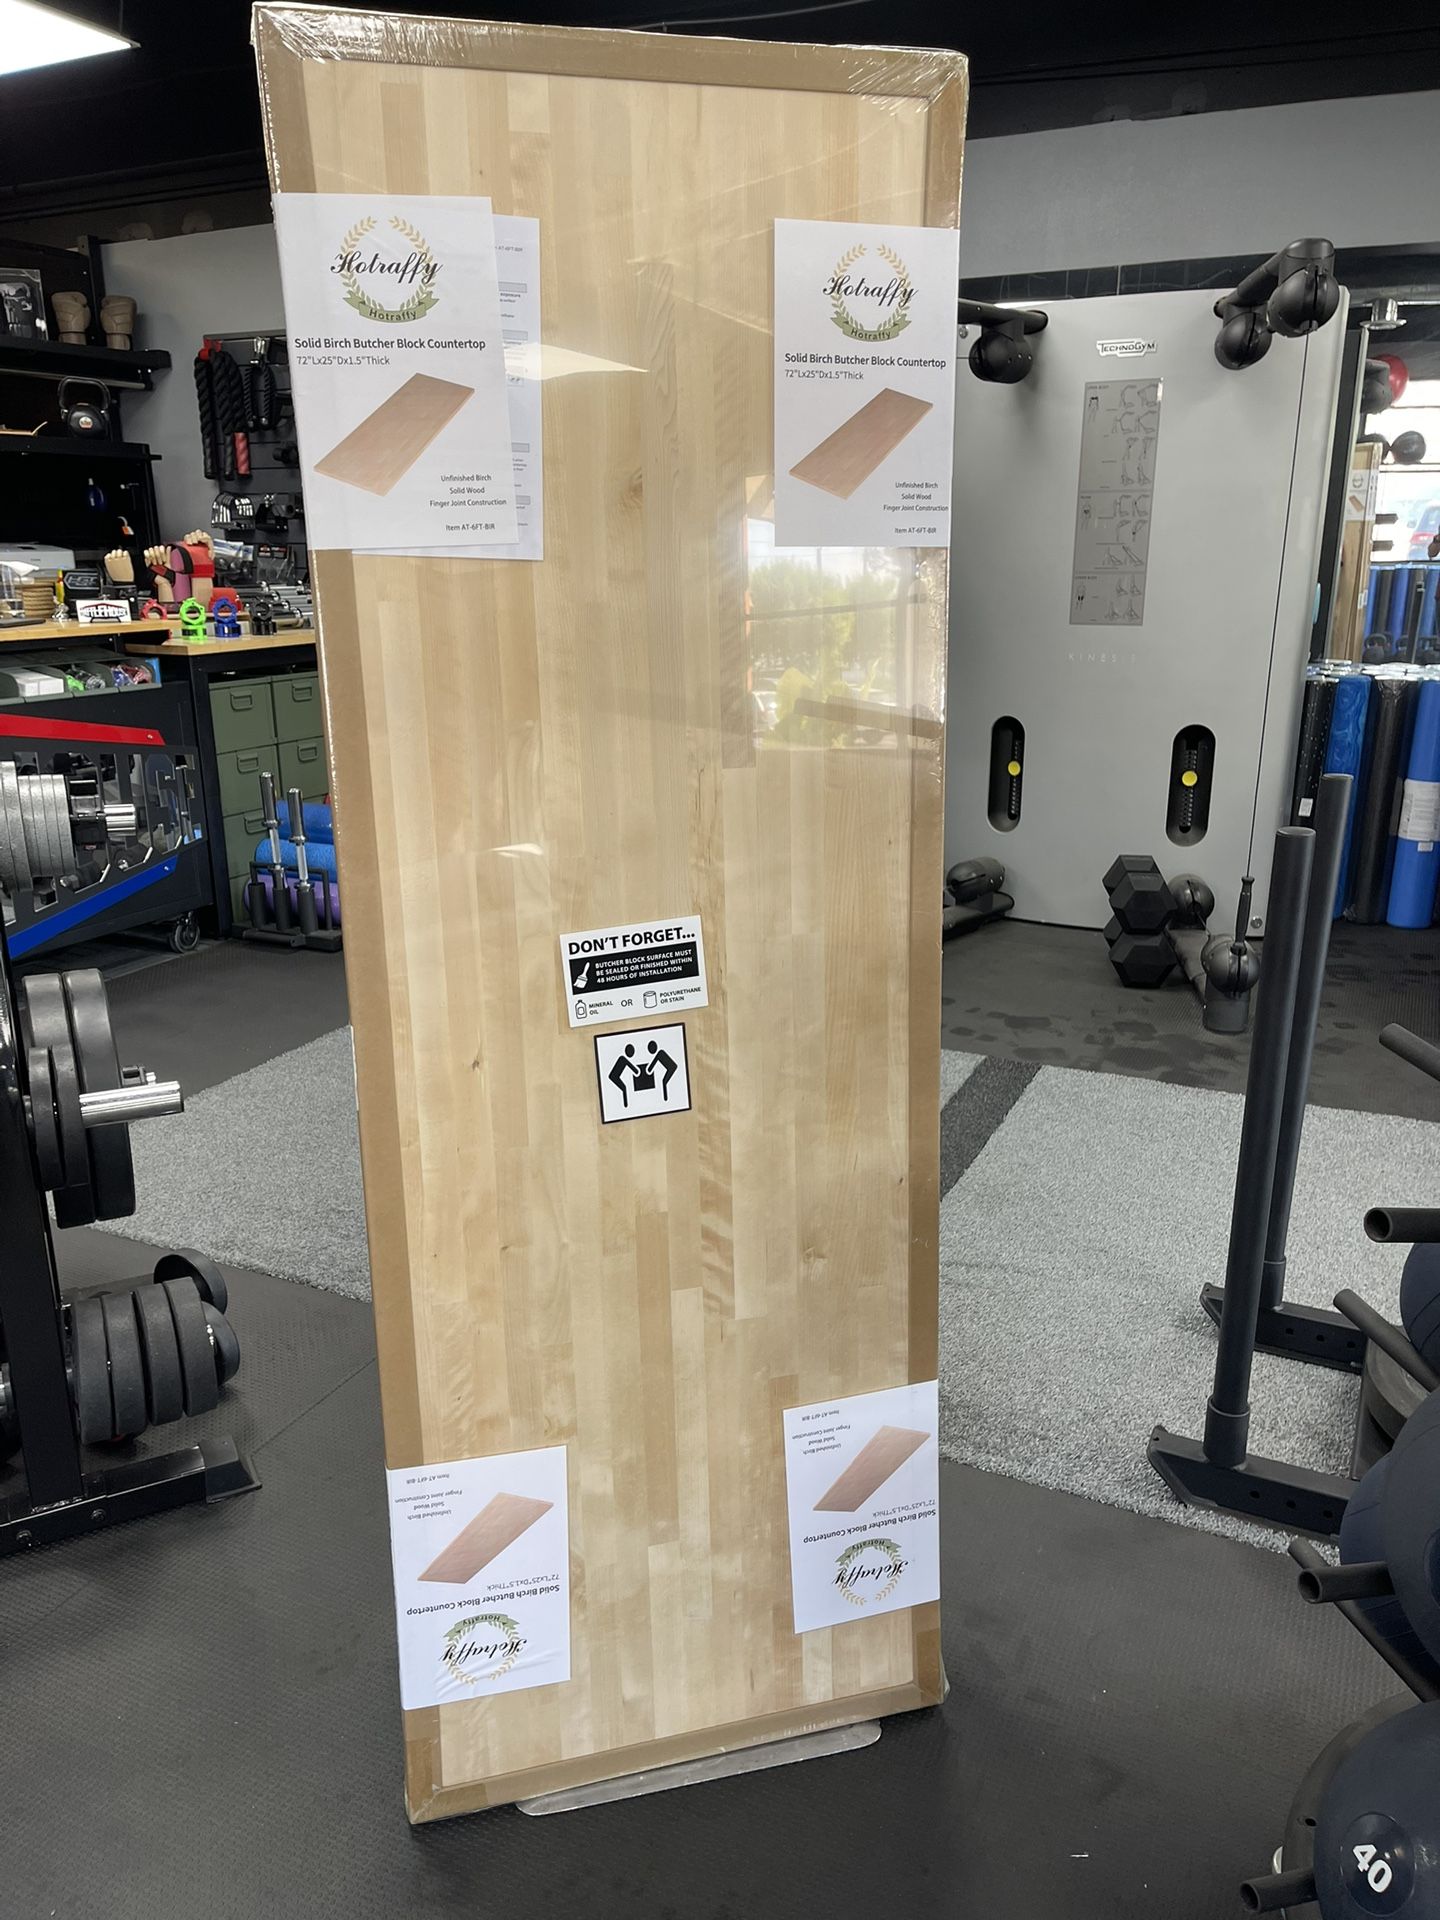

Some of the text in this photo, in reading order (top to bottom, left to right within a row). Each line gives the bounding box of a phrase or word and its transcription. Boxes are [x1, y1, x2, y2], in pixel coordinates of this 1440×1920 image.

[330, 251, 443, 284] Hotraffy
[823, 275, 919, 307] Hotraffy
[369, 308, 417, 321] Hotraffy
[850, 329, 891, 341] Hotraffy
[294, 338, 486, 350] Solid Birch Butcher Block Countertop
[1097, 342, 1155, 353] TECHNOGYM
[785, 353, 947, 369] Solid Birch Butcher Block Countertop
[440, 474, 474, 482] Unfinished
[430, 498, 507, 508] Finger Joint Construction
[883, 504, 901, 512] Finger
[461, 523, 495, 531] AT-6FT-BIR
[568, 926, 695, 955] DON'T FORGET...
[595, 949, 692, 969] BUTCHER BLOCK SURFACE MUST
[605, 966, 629, 975] SEALED
[640, 960, 669, 970] FINISHED
[670, 956, 693, 966] WITHIN
[606, 973, 628, 983] HOURS
[639, 966, 683, 977] INSTALLATION
[659, 987, 701, 998] POLYURETHANE
[589, 1001, 613, 1009] MINERAL
[621, 999, 633, 1008] OR
[669, 996, 685, 1004] STAIN
[792, 1430, 823, 1440] Construction
[816, 1443, 842, 1452] Unfinished
[394, 1495, 430, 1503] Construction
[445, 1489, 463, 1497] Finger
[422, 1509, 452, 1518] Unfinished
[803, 1508, 936, 1544] Solid Birch Butcher Block Countertop
[852, 1539, 885, 1551] Hotraffy
[832, 1560, 909, 1589] Hotraffy
[406, 1584, 560, 1616] Solid Birch Butcher Block Countertop
[462, 1615, 501, 1627] Hotraffy
[439, 1639, 527, 1666] Hotraffy
[1352, 1844, 1393, 1893] 40
